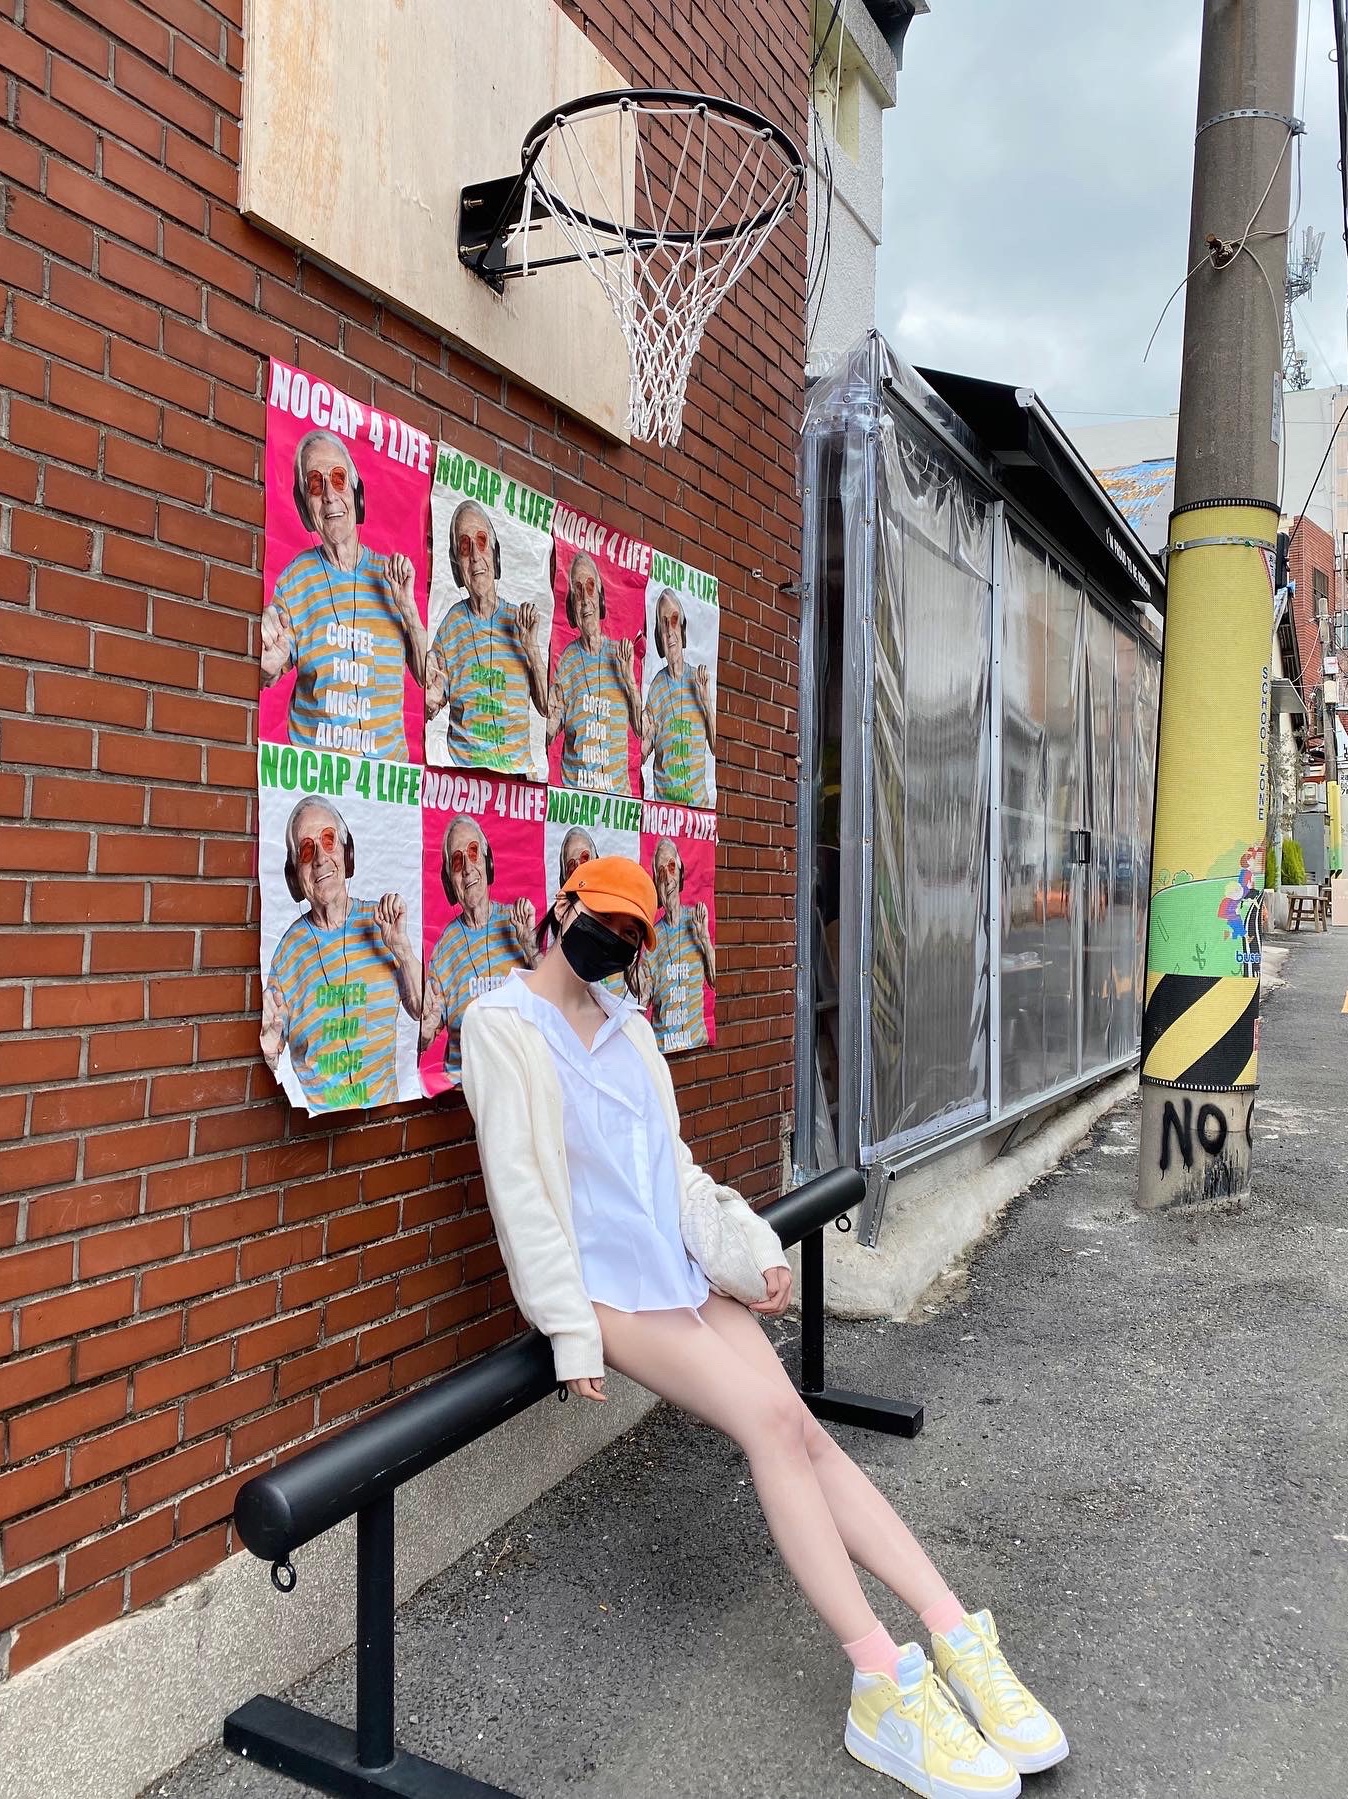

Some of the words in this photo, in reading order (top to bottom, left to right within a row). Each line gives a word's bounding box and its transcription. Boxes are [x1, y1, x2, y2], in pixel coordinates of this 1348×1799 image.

[270, 363, 364, 440] NOCAP
[369, 411, 385, 453] 4
[388, 418, 431, 475] LIFE
[436, 452, 502, 508] NOCAP
[504, 481, 517, 517] 4
[519, 487, 555, 535] LIFE
[553, 505, 608, 557] NOCAP
[607, 532, 620, 564] 4
[618, 536, 651, 576] LIFE
[651, 552, 685, 592] OCAP
[689, 569, 696, 597] 4
[697, 572, 718, 606] LIFE
[326, 622, 374, 656] COFFEE
[333, 657, 368, 687] FOOD
[325, 689, 371, 720] MUSIC
[582, 694, 611, 718] COFFEE
[1260, 666, 1269, 755] SCHOOL
[315, 722, 379, 754] ALCOHOL
[585, 719, 607, 741] FOOD
[582, 743, 610, 766] MUSIC
[261, 744, 351, 796] NOCAP
[355, 761, 371, 799] 4
[377, 763, 421, 806] LIFE
[422, 771, 492, 815] NOCAP
[494, 782, 507, 817] 4
[509, 783, 546, 822] LIFE
[1258, 764, 1266, 821] ZONE
[547, 789, 601, 827] NOCAP
[601, 798, 612, 829] 4
[613, 800, 642, 832] LIFE
[643, 804, 685, 837] NOCAP
[685, 811, 694, 839] 4
[693, 812, 717, 841] LIFE
[666, 963, 690, 981] COFFEE
[316, 983, 368, 1009] COFFEE
[321, 1016, 360, 1042] FOOD
[316, 1049, 363, 1075] MUSIC
